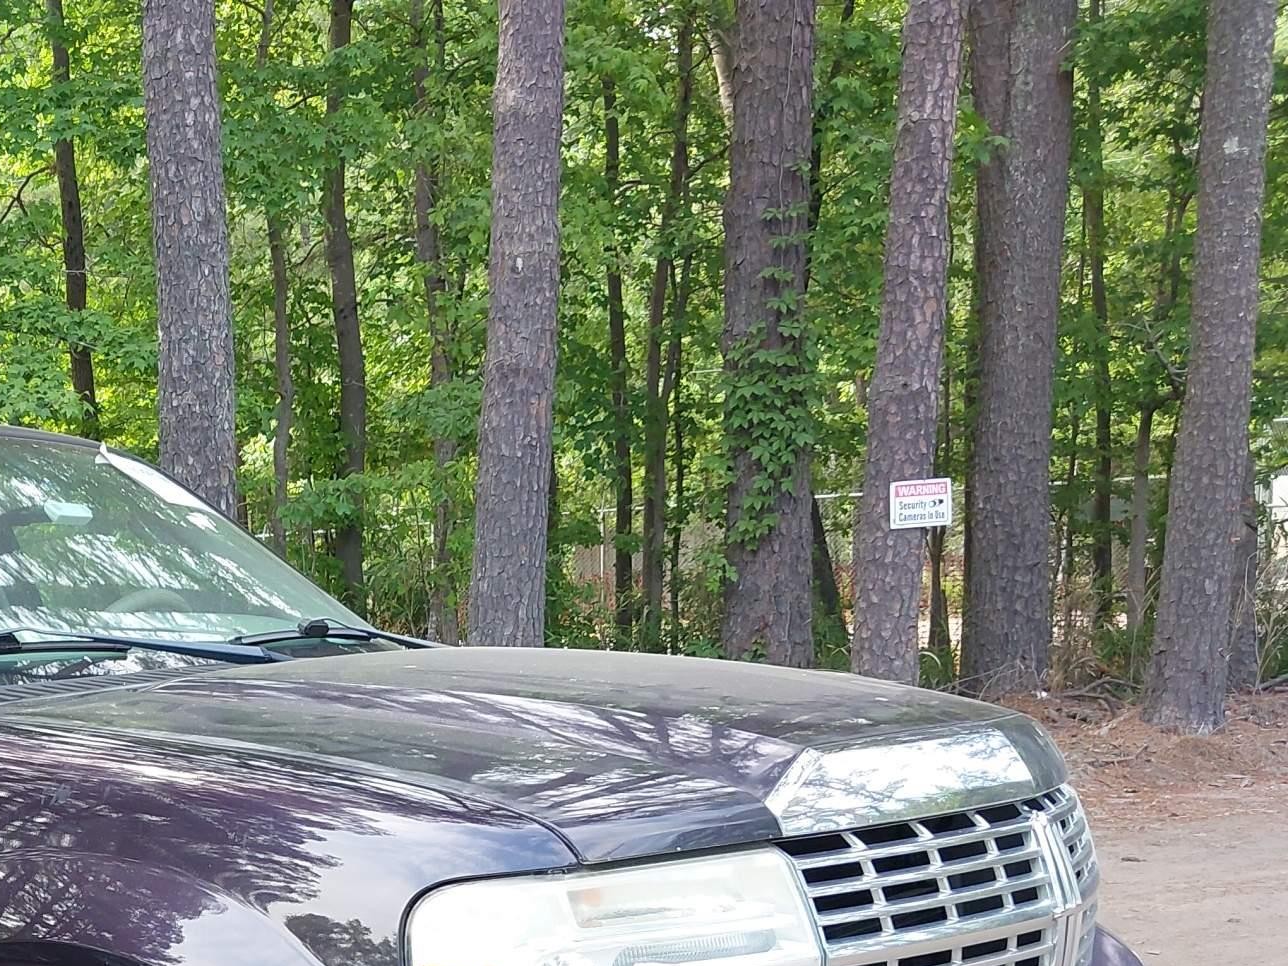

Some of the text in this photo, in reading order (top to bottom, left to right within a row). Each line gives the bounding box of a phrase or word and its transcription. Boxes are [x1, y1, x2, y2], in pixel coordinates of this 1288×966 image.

[897, 483, 947, 497] WARNING
[898, 500, 927, 511] Security
[898, 512, 927, 522] Cameras
[934, 510, 945, 520] Use
